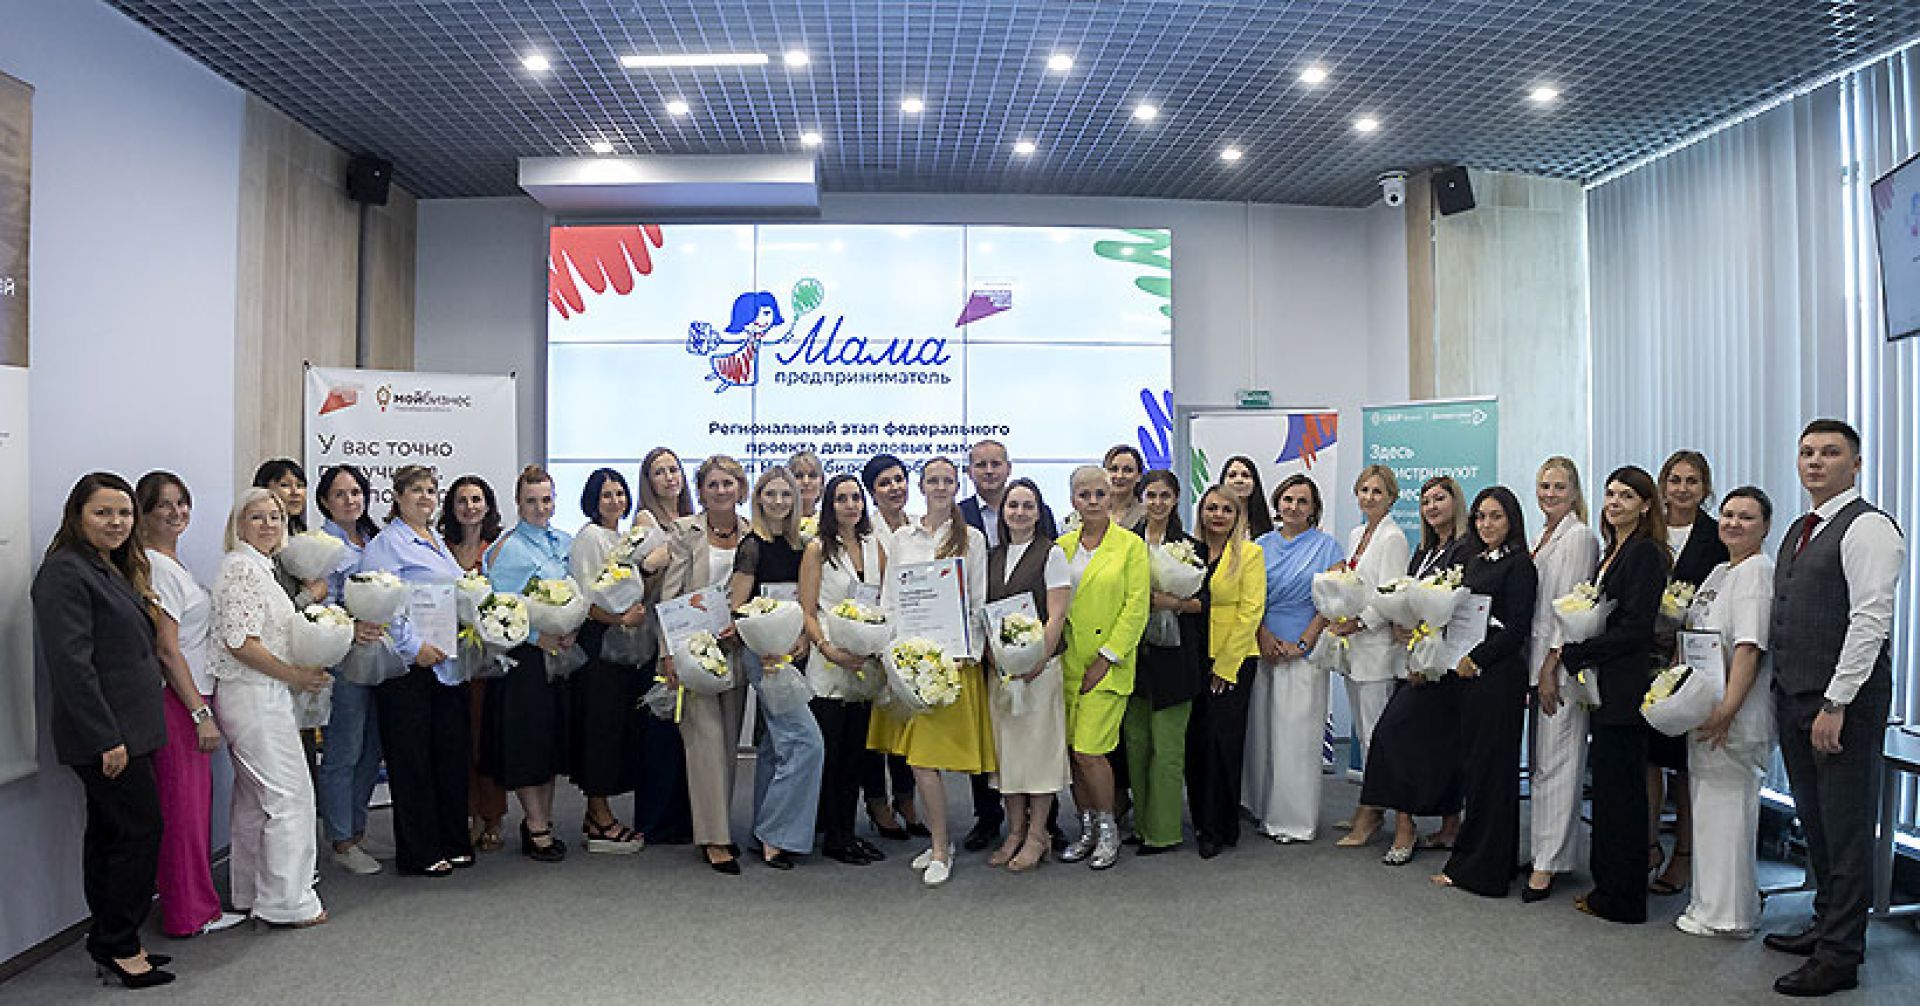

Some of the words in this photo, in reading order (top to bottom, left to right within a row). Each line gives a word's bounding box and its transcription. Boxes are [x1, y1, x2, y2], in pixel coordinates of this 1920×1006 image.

[775, 315, 951, 366] Мама
[774, 371, 952, 387] предприниматель
[708, 420, 837, 436] Региональный
[840, 422, 880, 436] этап
[882, 420, 1011, 438] федерального
[317, 434, 336, 455] У
[342, 440, 380, 457] вас
[385, 440, 453, 457] точно
[746, 441, 818, 456] проекта
[820, 441, 853, 455] для
[856, 441, 933, 455] деловых
[1369, 443, 1415, 461] Здесь
[1391, 466, 1480, 483] истрируют
